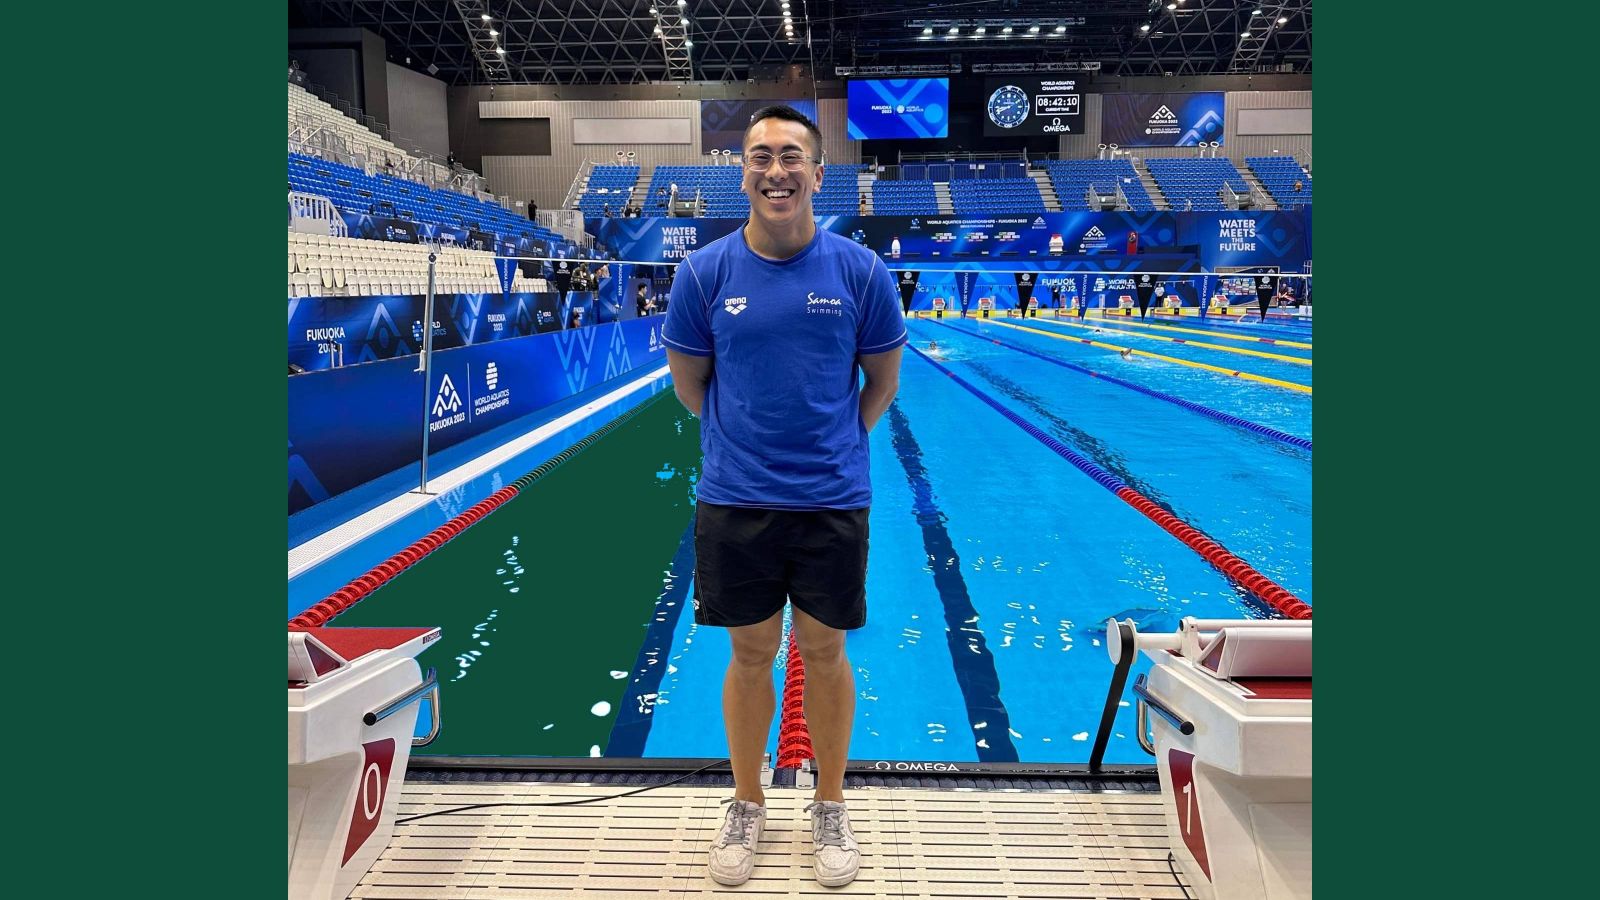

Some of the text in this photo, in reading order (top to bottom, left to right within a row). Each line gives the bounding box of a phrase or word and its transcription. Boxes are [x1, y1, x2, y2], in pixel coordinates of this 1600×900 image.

[1038, 98, 1077, 106] 08:42:10
[1219, 219, 1256, 228] WATER
[662, 227, 697, 235] WATER
[1220, 229, 1256, 237] MEETS
[663, 236, 697, 245] MEETS
[663, 250, 696, 258] FUTUR
[724, 297, 746, 306] arena
[807, 292, 842, 305] Samoa
[807, 306, 842, 317] Swimming
[487, 314, 506, 323] FUKUOKA
[493, 323, 503, 331] 2023
[306, 327, 346, 341] FUKUOKA
[474, 389, 510, 406] WORLD AQUATICS
[475, 398, 510, 416] CHAMPIONSHIPS
[430, 412, 465, 432] FUKUOKA 2023
[896, 762, 960, 771] OMEGA
[364, 762, 380, 820] 0
[1183, 781, 1192, 835] 1
